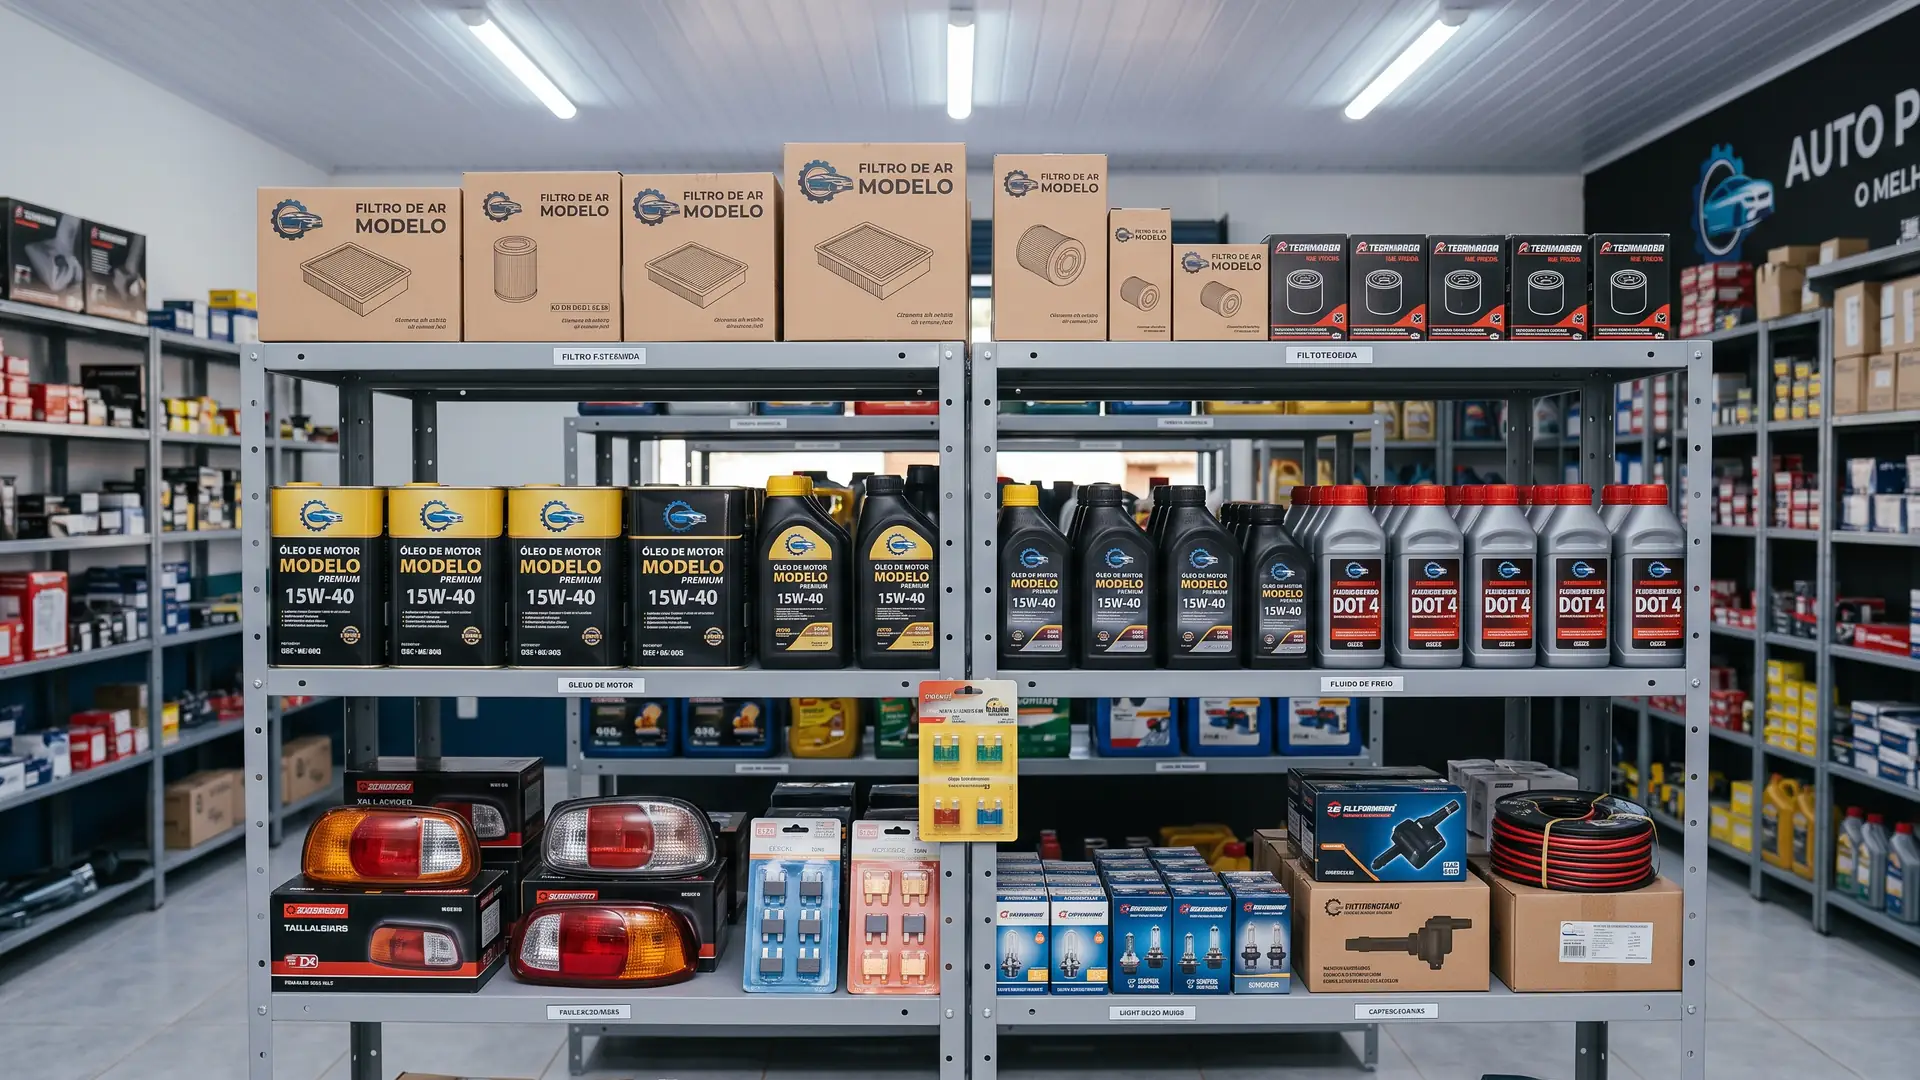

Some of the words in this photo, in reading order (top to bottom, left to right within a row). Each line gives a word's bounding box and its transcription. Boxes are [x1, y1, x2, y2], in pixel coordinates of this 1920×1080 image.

[1784, 104, 1884, 188] AUTO
[859, 162, 907, 174] FILTRO
[910, 163, 930, 174] DE
[934, 163, 954, 174] AR
[858, 178, 954, 194] MODELO
[1041, 183, 1099, 193] MODELO
[540, 193, 575, 202] FILTRO
[578, 193, 594, 202] DE
[595, 193, 610, 202] AR
[684, 190, 724, 200] FILTRO
[728, 190, 744, 200] DE
[746, 191, 764, 200] AR
[1854, 182, 1870, 208] O
[355, 203, 402, 213] FILTRO
[406, 203, 424, 213] DE
[428, 203, 446, 213] AR
[540, 204, 610, 218] MODELO
[684, 204, 764, 218] MODELO
[355, 218, 447, 234] MODELO
[1212, 262, 1262, 271] MODELO
[280, 545, 306, 555] ÓLEO
[308, 547, 322, 555] DE
[324, 546, 360, 555] MOTOR
[400, 545, 427, 556] ÓLEO
[429, 547, 442, 556] DE
[444, 547, 482, 556] MOTOR
[520, 546, 547, 556] ÓLEO
[548, 548, 562, 556] DE
[564, 548, 602, 556] MOTOR
[642, 546, 669, 556] ÓLEO
[671, 548, 684, 556] DE
[686, 548, 724, 556] MOTOR
[280, 558, 360, 573] MODELO
[400, 559, 482, 574] MODELO
[520, 560, 601, 574] MODELO
[642, 560, 724, 574] MODELO
[560, 576, 602, 584] PREMIUM
[682, 576, 724, 584] PREMIUM
[774, 572, 828, 582] MODELO
[874, 572, 929, 582] MODELO
[1011, 580, 1058, 588] MODELO
[1096, 580, 1144, 588] MODELO
[1181, 580, 1228, 589] MODELO
[286, 588, 354, 604] 15W-40
[406, 588, 476, 604] 15W-40
[527, 590, 596, 605] 15W-40
[648, 590, 718, 605] 15W-40
[778, 593, 824, 604] 15W-40
[878, 592, 925, 604] 15W-40
[1262, 590, 1303, 598] MODELO
[1012, 598, 1056, 608] 15W-40
[1098, 598, 1140, 608] 15W-40
[1183, 598, 1226, 608] 15W-40
[1333, 598, 1366, 614] DOT
[1369, 598, 1379, 614] 4
[1412, 598, 1444, 614] DOT
[1448, 598, 1457, 614] 4
[1485, 597, 1518, 613] DOT
[1521, 597, 1530, 613] 4
[1559, 597, 1593, 613] DOT
[1595, 597, 1605, 613] 4
[1635, 597, 1670, 612] DOT
[1672, 597, 1681, 612] 4
[1264, 606, 1302, 616] 15W-40
